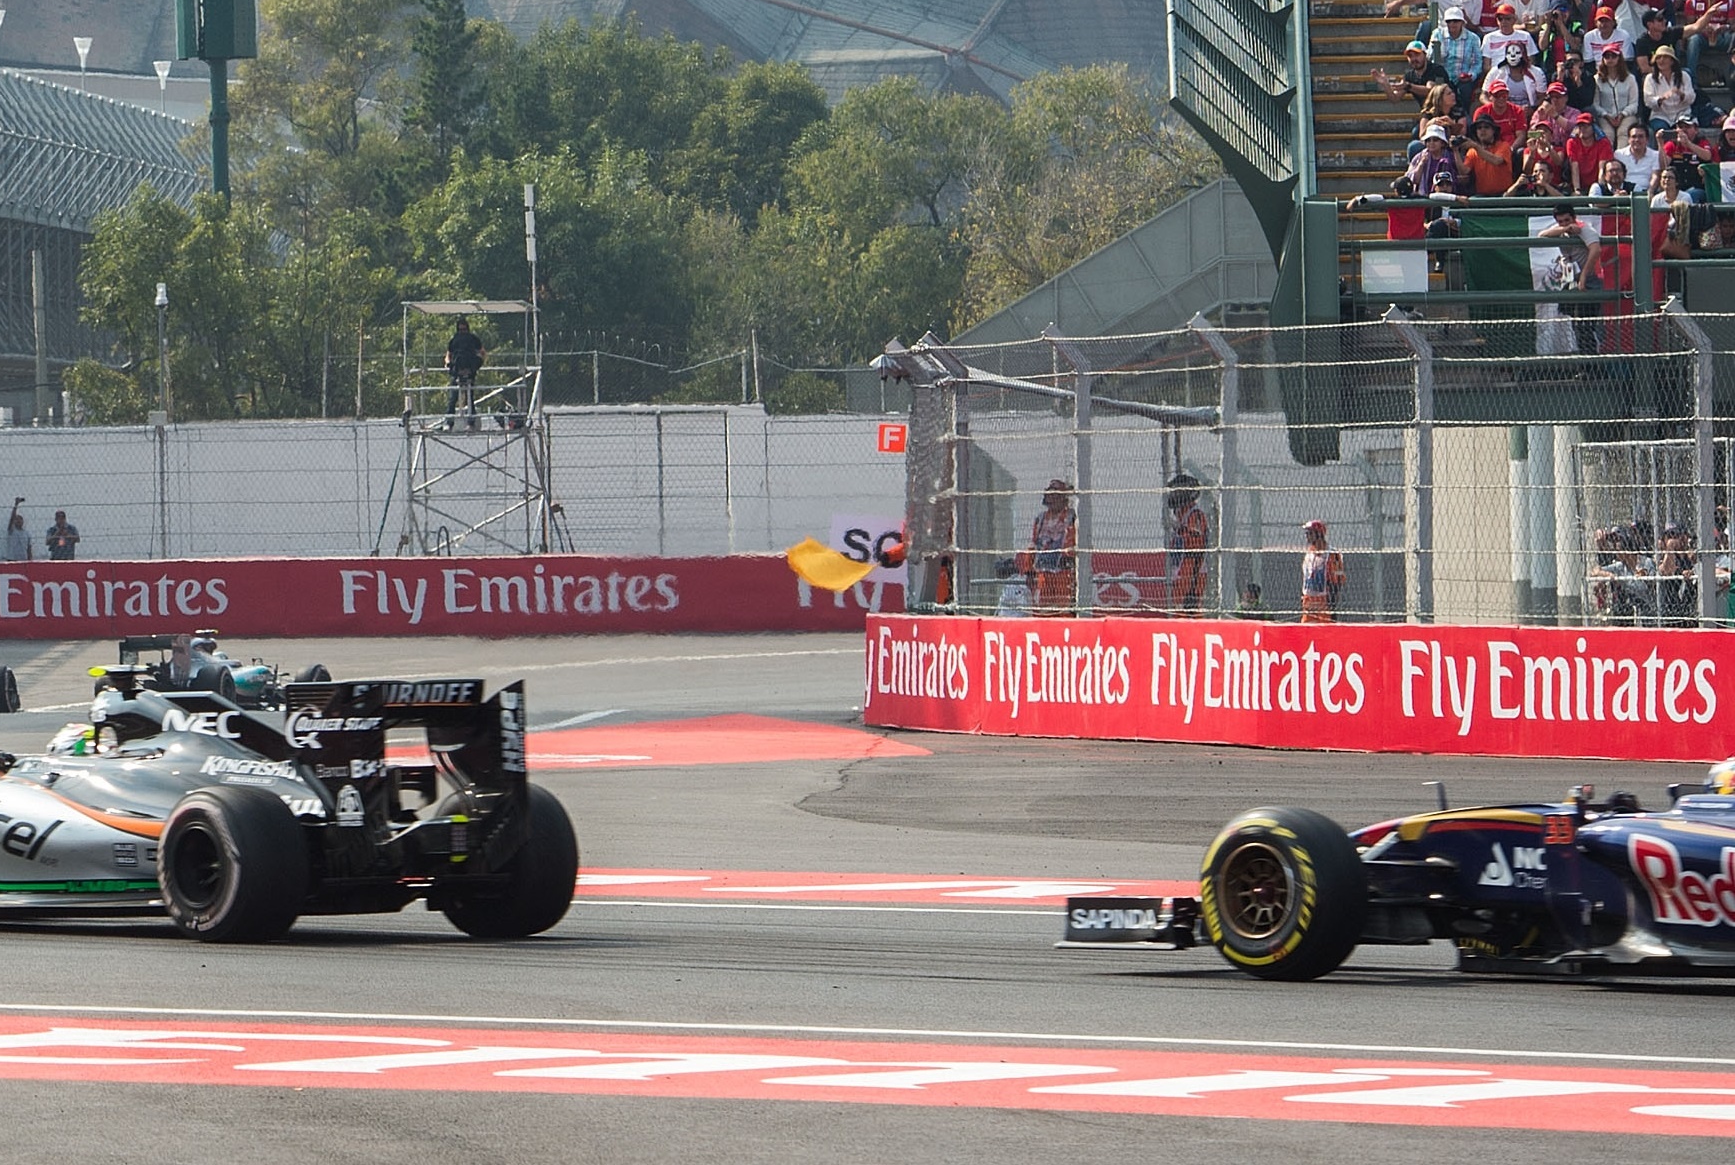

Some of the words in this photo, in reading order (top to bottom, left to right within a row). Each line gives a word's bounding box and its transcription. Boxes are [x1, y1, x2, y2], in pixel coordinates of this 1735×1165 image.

[882, 426, 902, 450] F
[340, 569, 428, 624] Fly
[443, 564, 680, 616] Emirates
[878, 624, 968, 700] Emirates
[984, 628, 1025, 718] Fly
[1025, 627, 1130, 705] Emirates
[1151, 633, 1199, 724] Fly
[1204, 630, 1365, 715] Emirates
[1400, 639, 1479, 737] Fly
[1489, 637, 1717, 725] Emirates
[163, 709, 241, 739] NEC
[1071, 908, 1158, 931] SAPINDA
